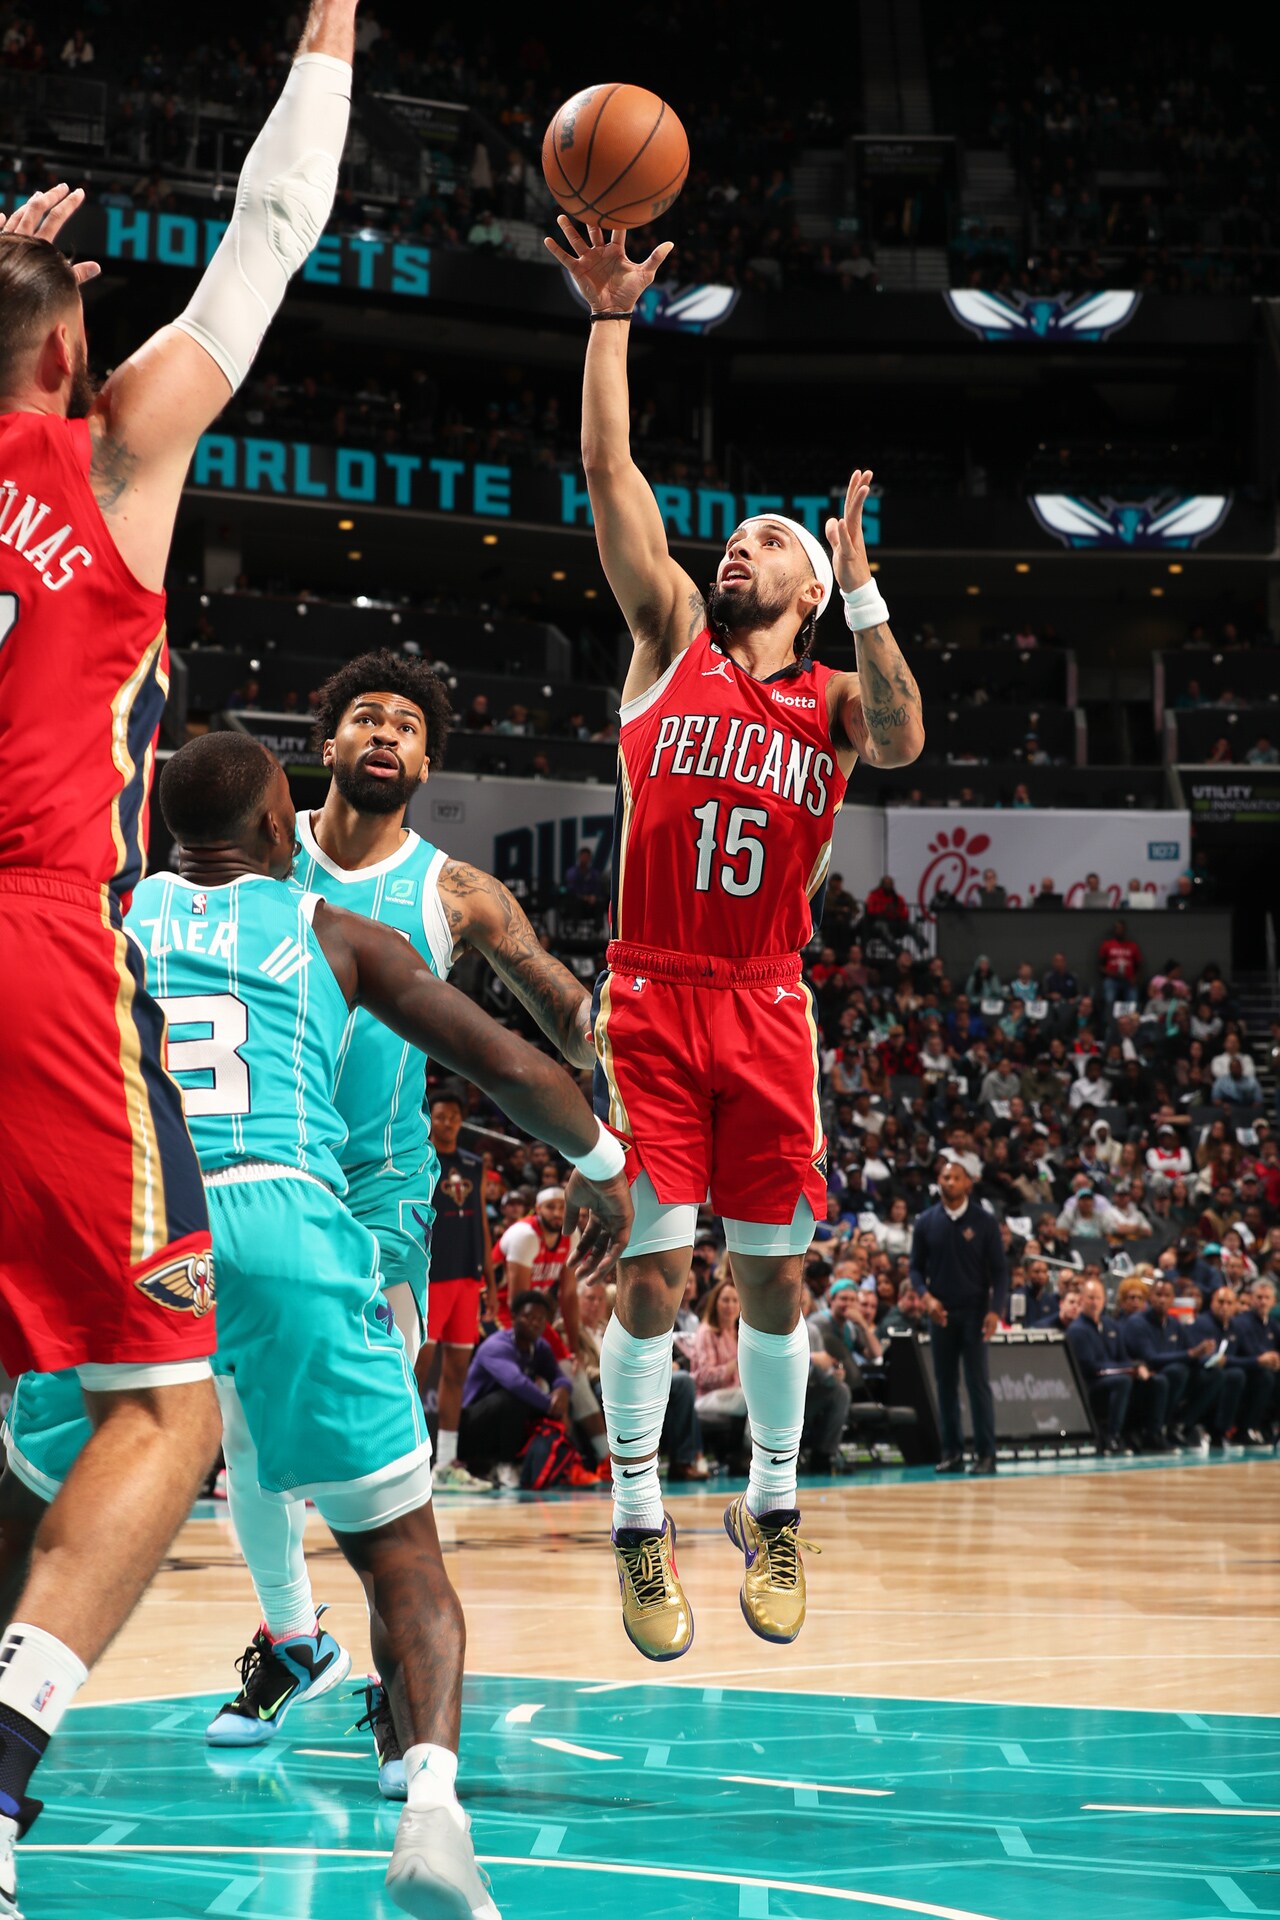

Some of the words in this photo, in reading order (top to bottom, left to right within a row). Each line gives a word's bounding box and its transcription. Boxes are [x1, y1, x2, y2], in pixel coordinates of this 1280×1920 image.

[106, 207, 430, 297] HOETS
[560, 473, 880, 544] HRNTS
[770, 688, 817, 709] ibotta
[648, 713, 835, 818] PELICANS
[1192, 785, 1252, 799] UTILITY
[692, 798, 769, 897] 15
[1151, 843, 1176, 858] 107
[154, 992, 251, 1117] 3
